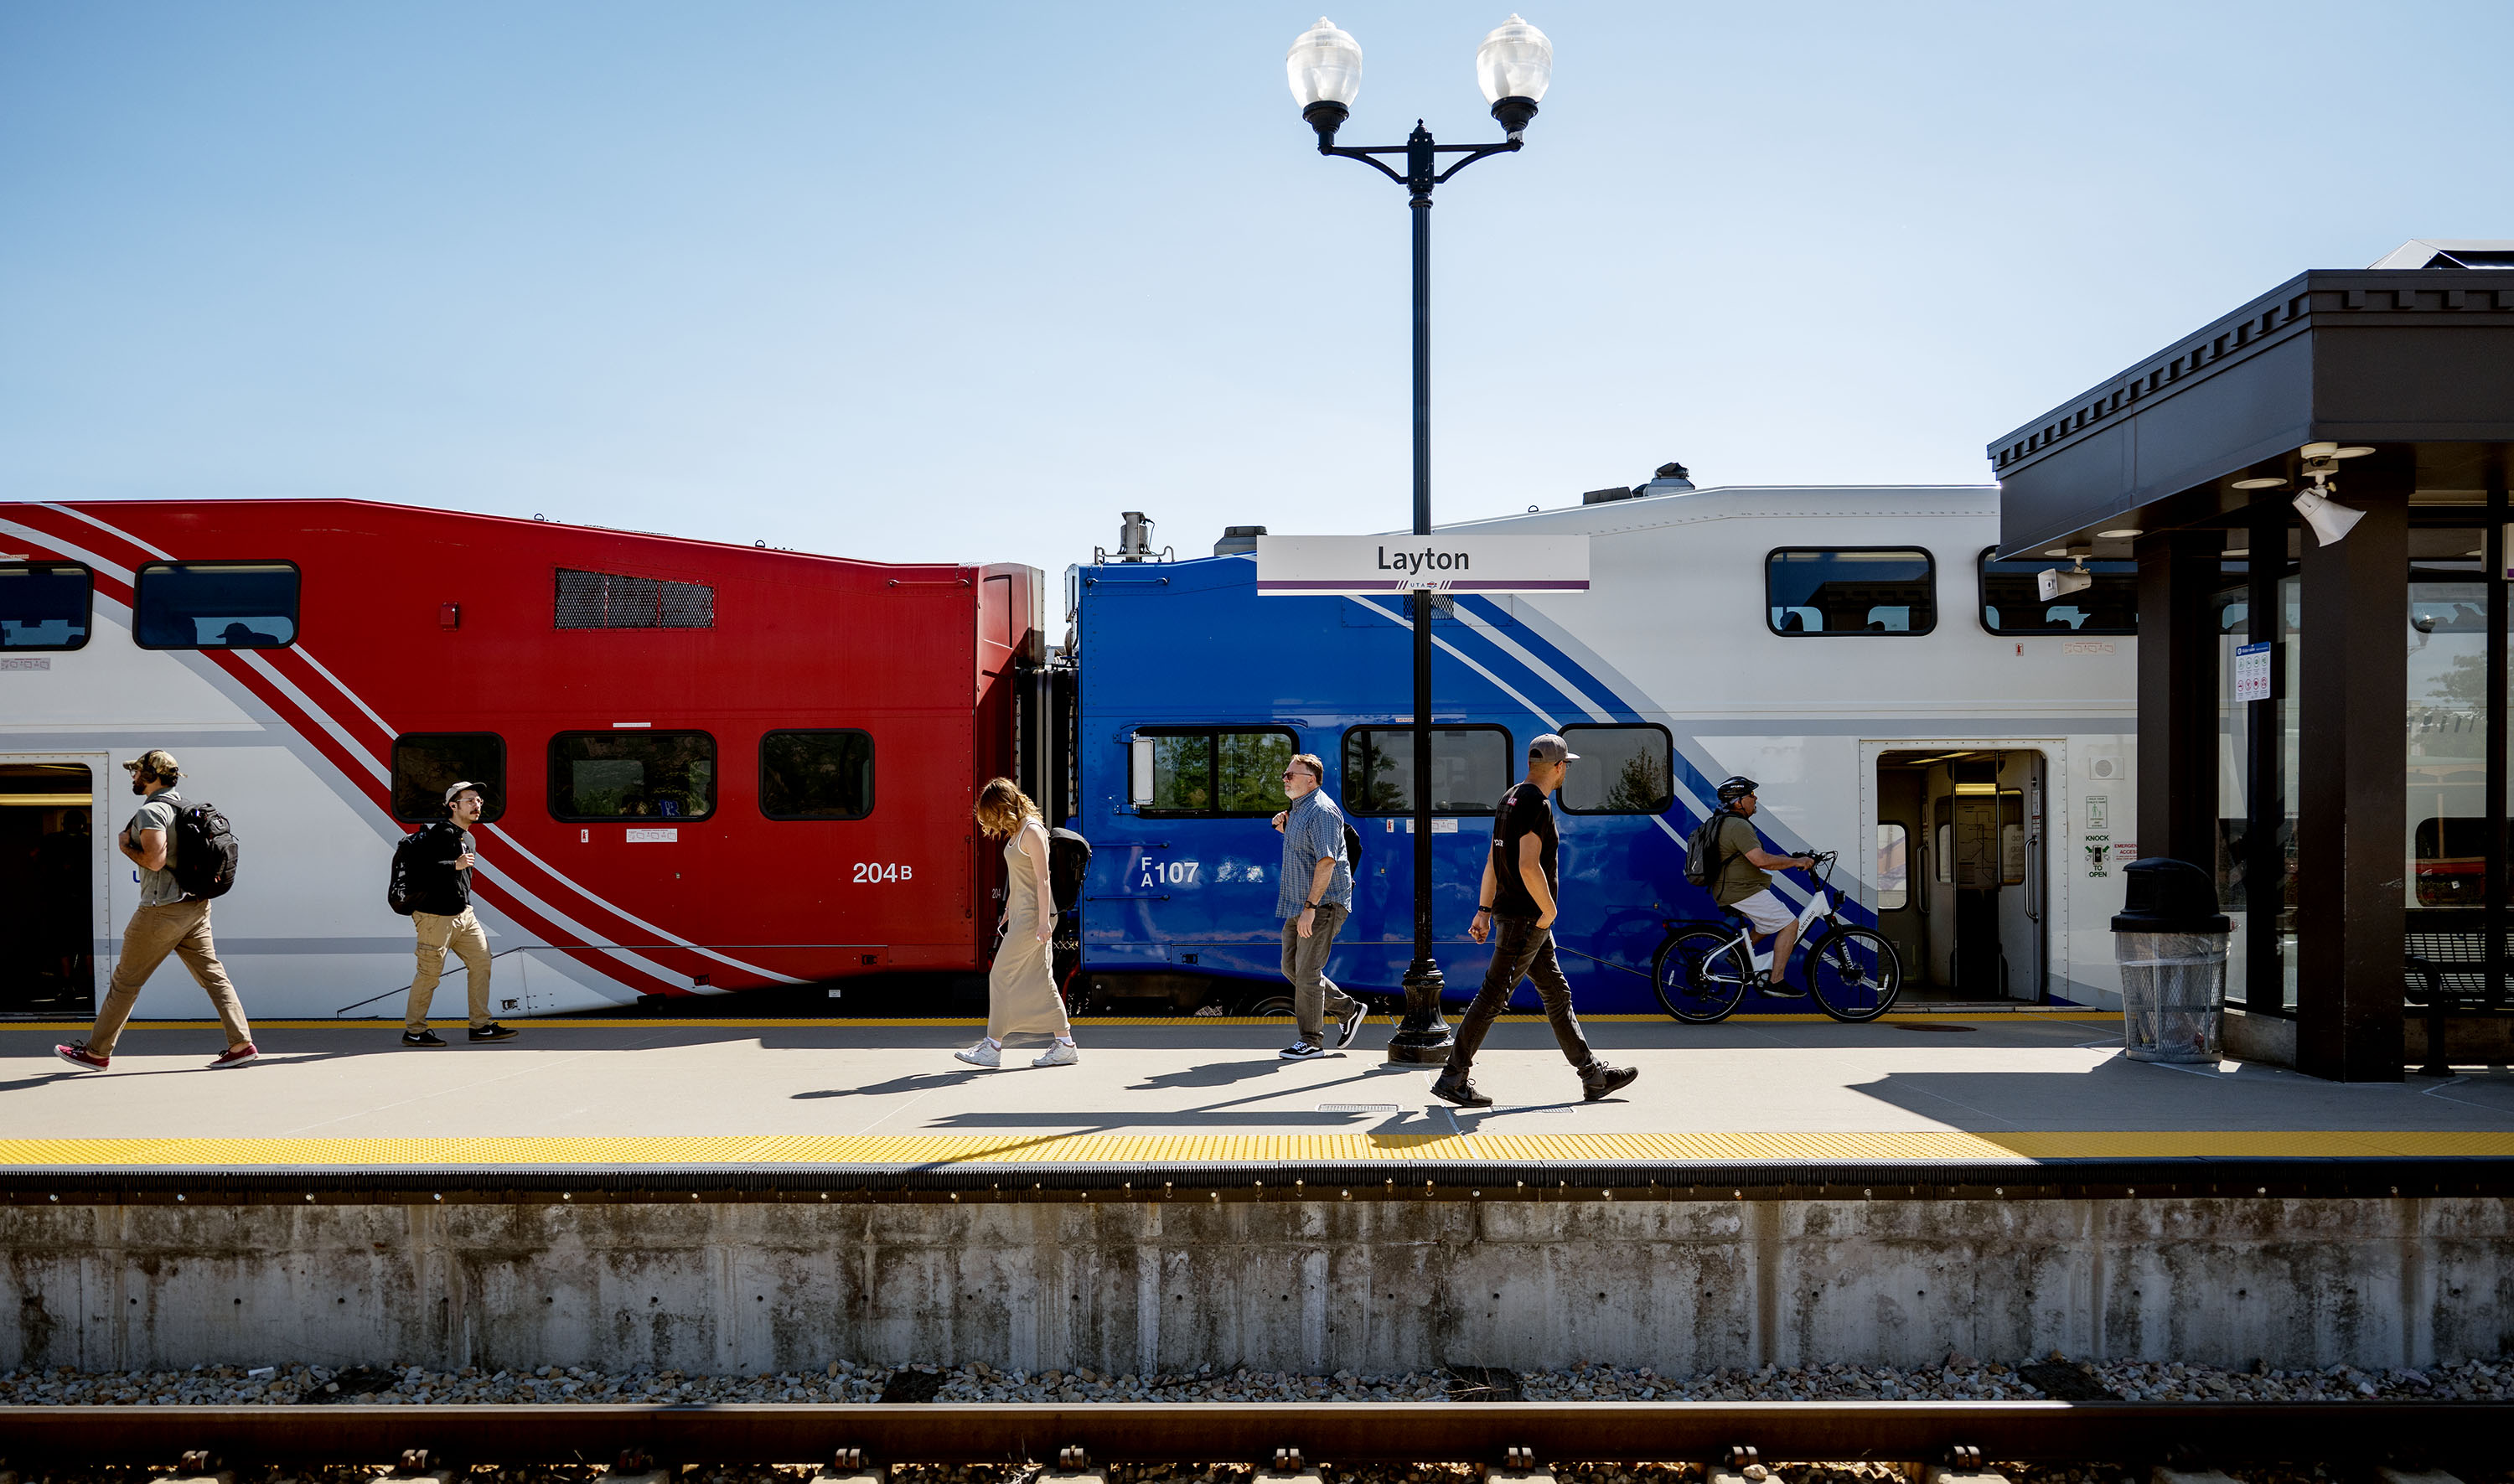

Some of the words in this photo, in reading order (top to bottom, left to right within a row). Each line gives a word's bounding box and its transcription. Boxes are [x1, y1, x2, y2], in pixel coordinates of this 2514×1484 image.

[1379, 546, 1469, 576] Layton
[1141, 856, 1152, 871] F
[1141, 872, 1154, 887] A
[1155, 862, 1199, 884] 107
[991, 888, 1001, 899] 204
[1798, 910, 1816, 932] LECTRIC
